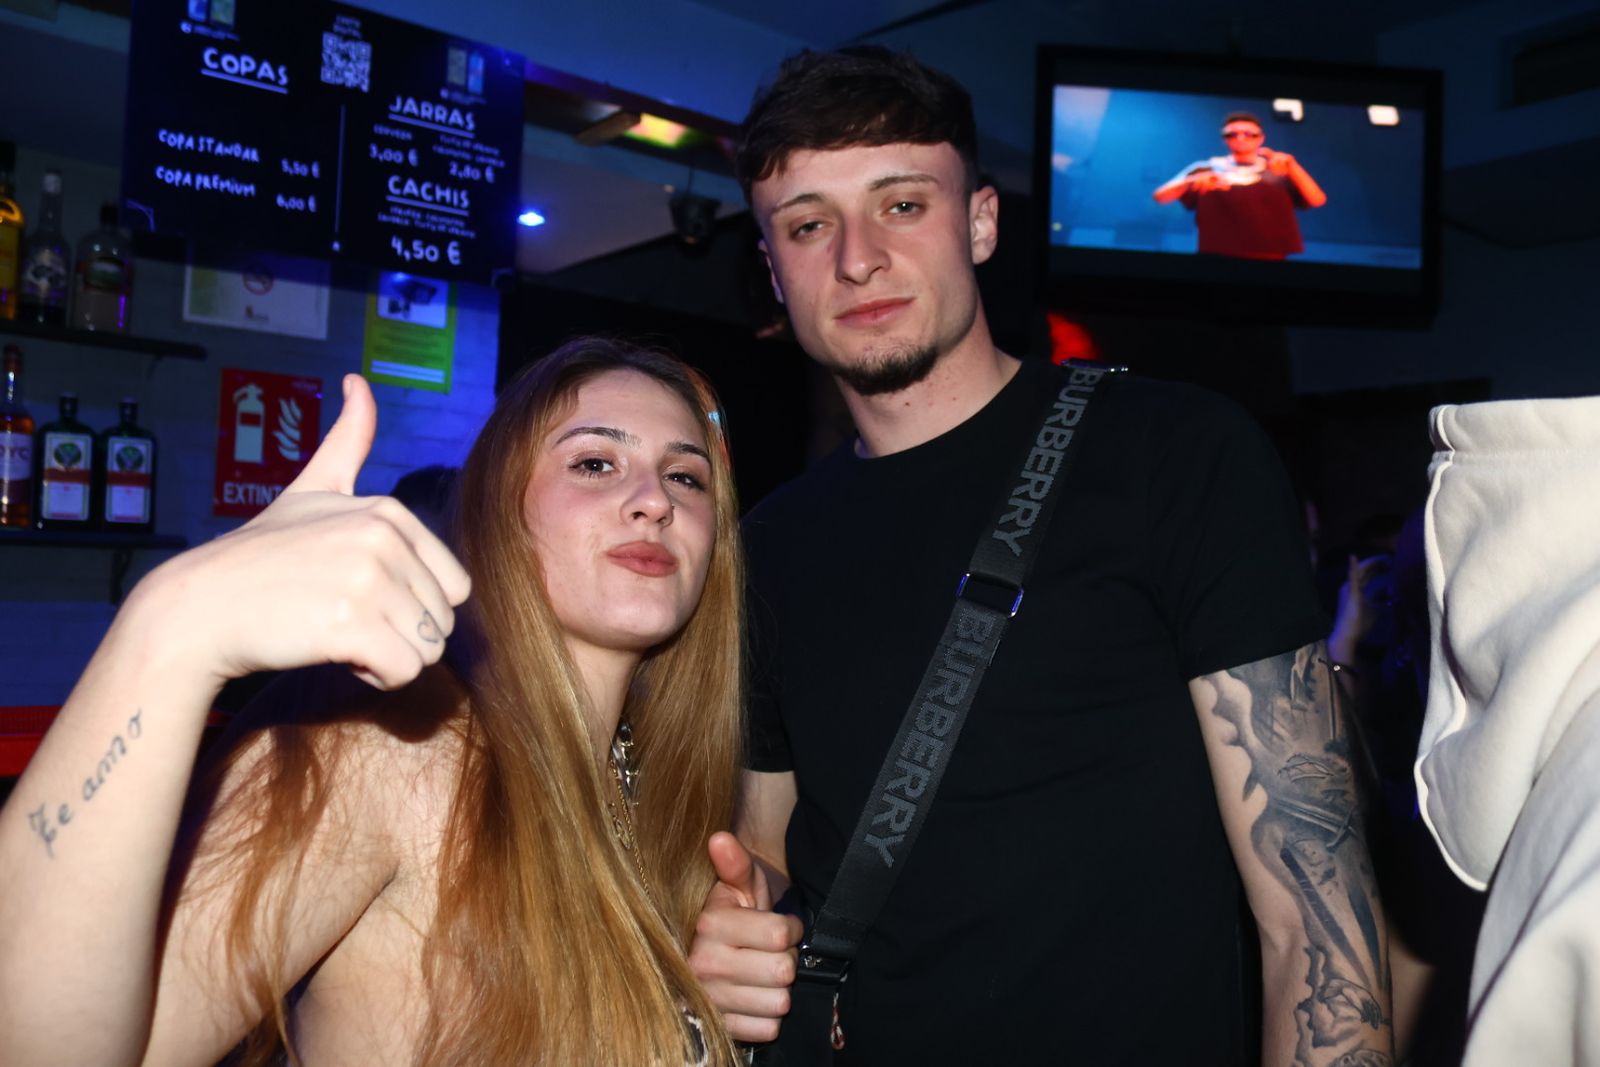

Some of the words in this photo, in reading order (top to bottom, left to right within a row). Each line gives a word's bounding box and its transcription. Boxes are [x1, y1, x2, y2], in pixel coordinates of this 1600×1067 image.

[203, 46, 289, 86] COPAS
[388, 95, 476, 131] JARRAS
[157, 128, 194, 151] COPA
[198, 135, 260, 163] STANDAR
[369, 142, 404, 165] 3,00
[407, 147, 419, 168] €
[155, 165, 192, 187] COPA
[311, 161, 320, 179] €
[484, 165, 495, 184] €
[308, 194, 317, 213] €
[387, 174, 470, 208] CACHIS
[391, 234, 440, 263] 4,50
[447, 240, 462, 266] €
[992, 368, 1104, 557] BURBERRY
[223, 480, 284, 505] EXTINT
[864, 608, 997, 868] BURBERRY
[82, 708, 142, 802] amo
